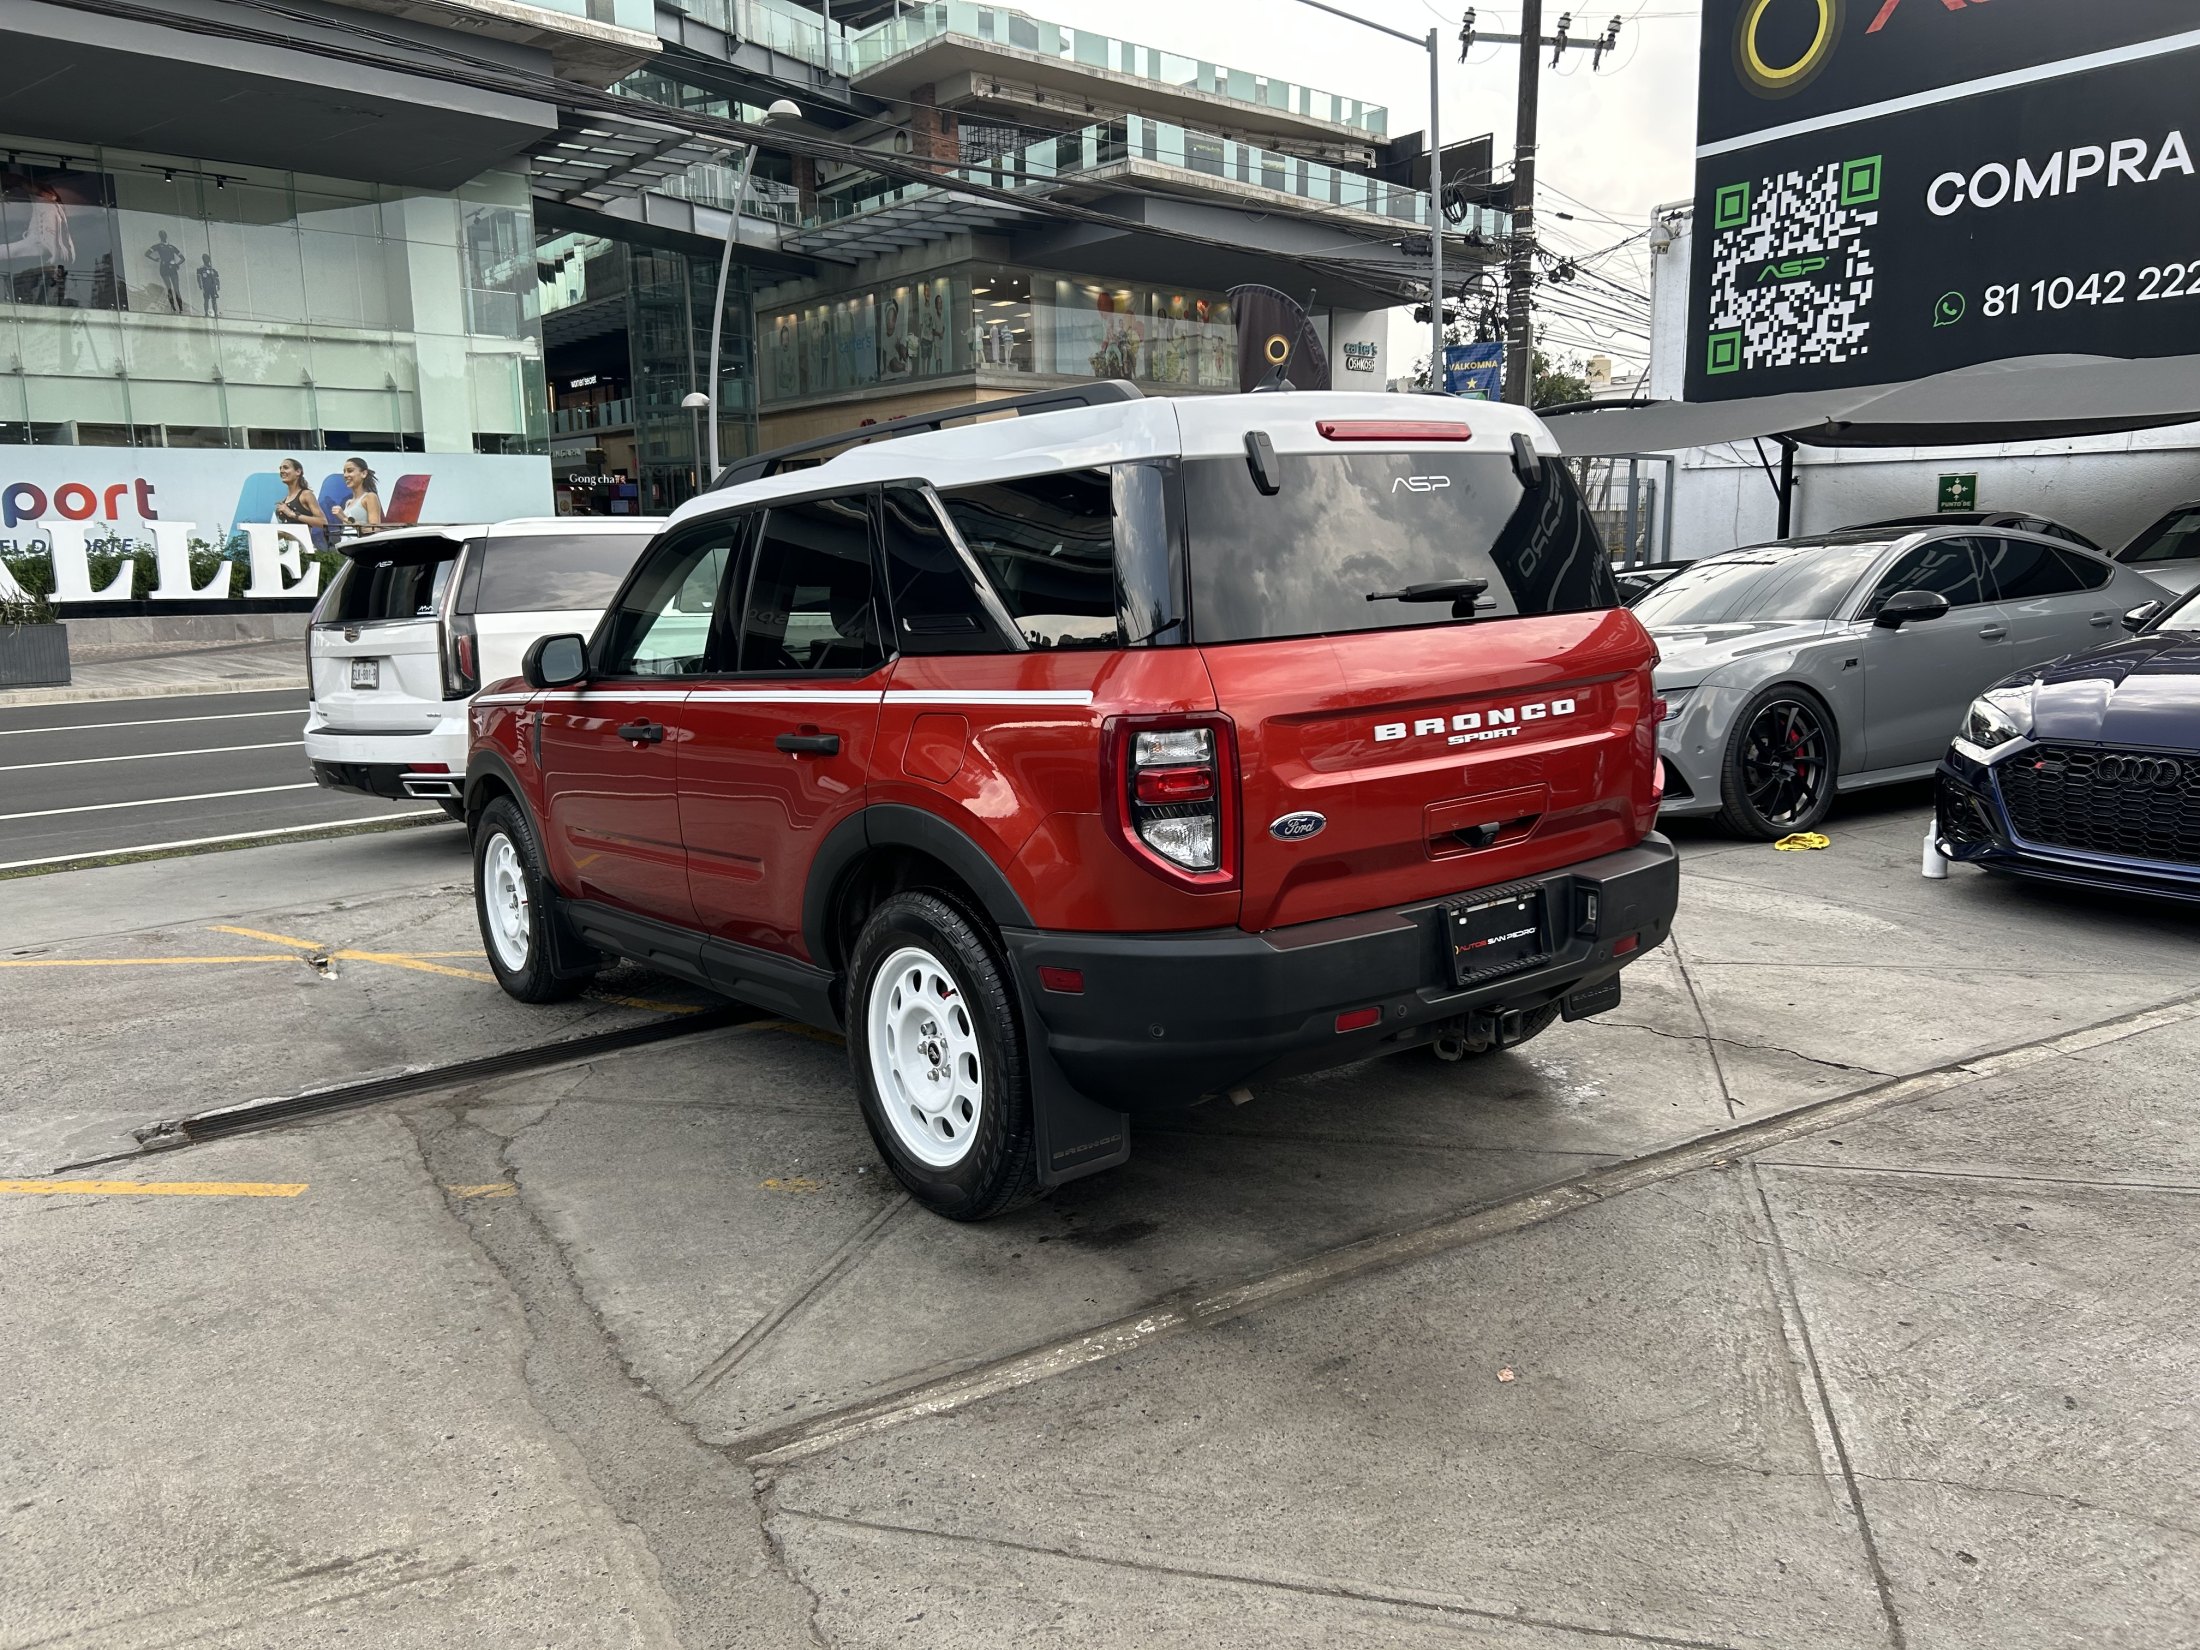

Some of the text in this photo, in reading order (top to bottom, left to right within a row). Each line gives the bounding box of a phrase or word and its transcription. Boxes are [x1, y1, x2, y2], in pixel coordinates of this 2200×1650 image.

[1926, 130, 2195, 217] COMPRA
[1982, 283, 2020, 317] 81
[2031, 270, 2126, 312] 1042
[569, 473, 597, 486] Gong
[597, 473, 615, 484] cha
[2, 478, 158, 528] port
[1374, 698, 1576, 742] BRONCO
[1447, 726, 1521, 745] SPORT
[1284, 816, 1316, 836] Ford
[1459, 927, 1535, 952] AUTOS SAN PEDRO
